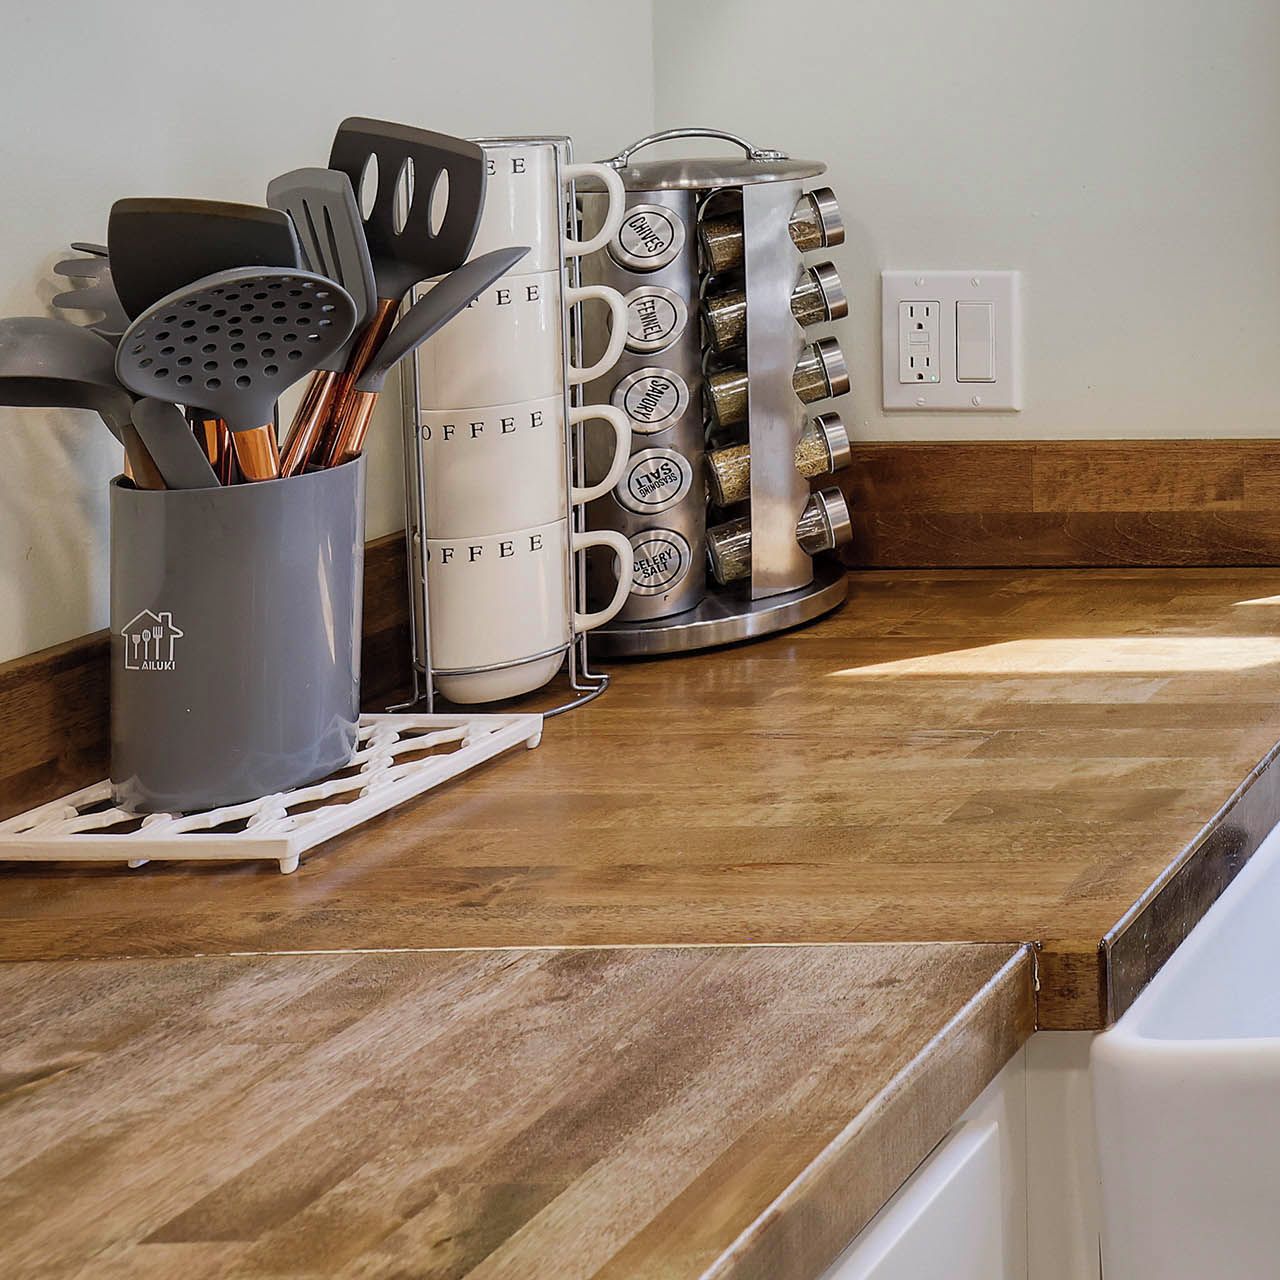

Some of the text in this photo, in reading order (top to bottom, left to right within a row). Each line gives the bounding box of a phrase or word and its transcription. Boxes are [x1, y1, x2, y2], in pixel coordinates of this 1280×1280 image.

[628, 216, 665, 253] CHIVES
[636, 299, 663, 340] FENNEL
[633, 379, 670, 420] SAVORY
[415, 411, 544, 441] OFFEE
[635, 462, 673, 490] SALT
[639, 472, 678, 498] SEASONING
[425, 534, 544, 564] FFEE
[633, 548, 673, 573] CELERY
[642, 561, 669, 579] SALT
[141, 661, 175, 671] AILUKI
